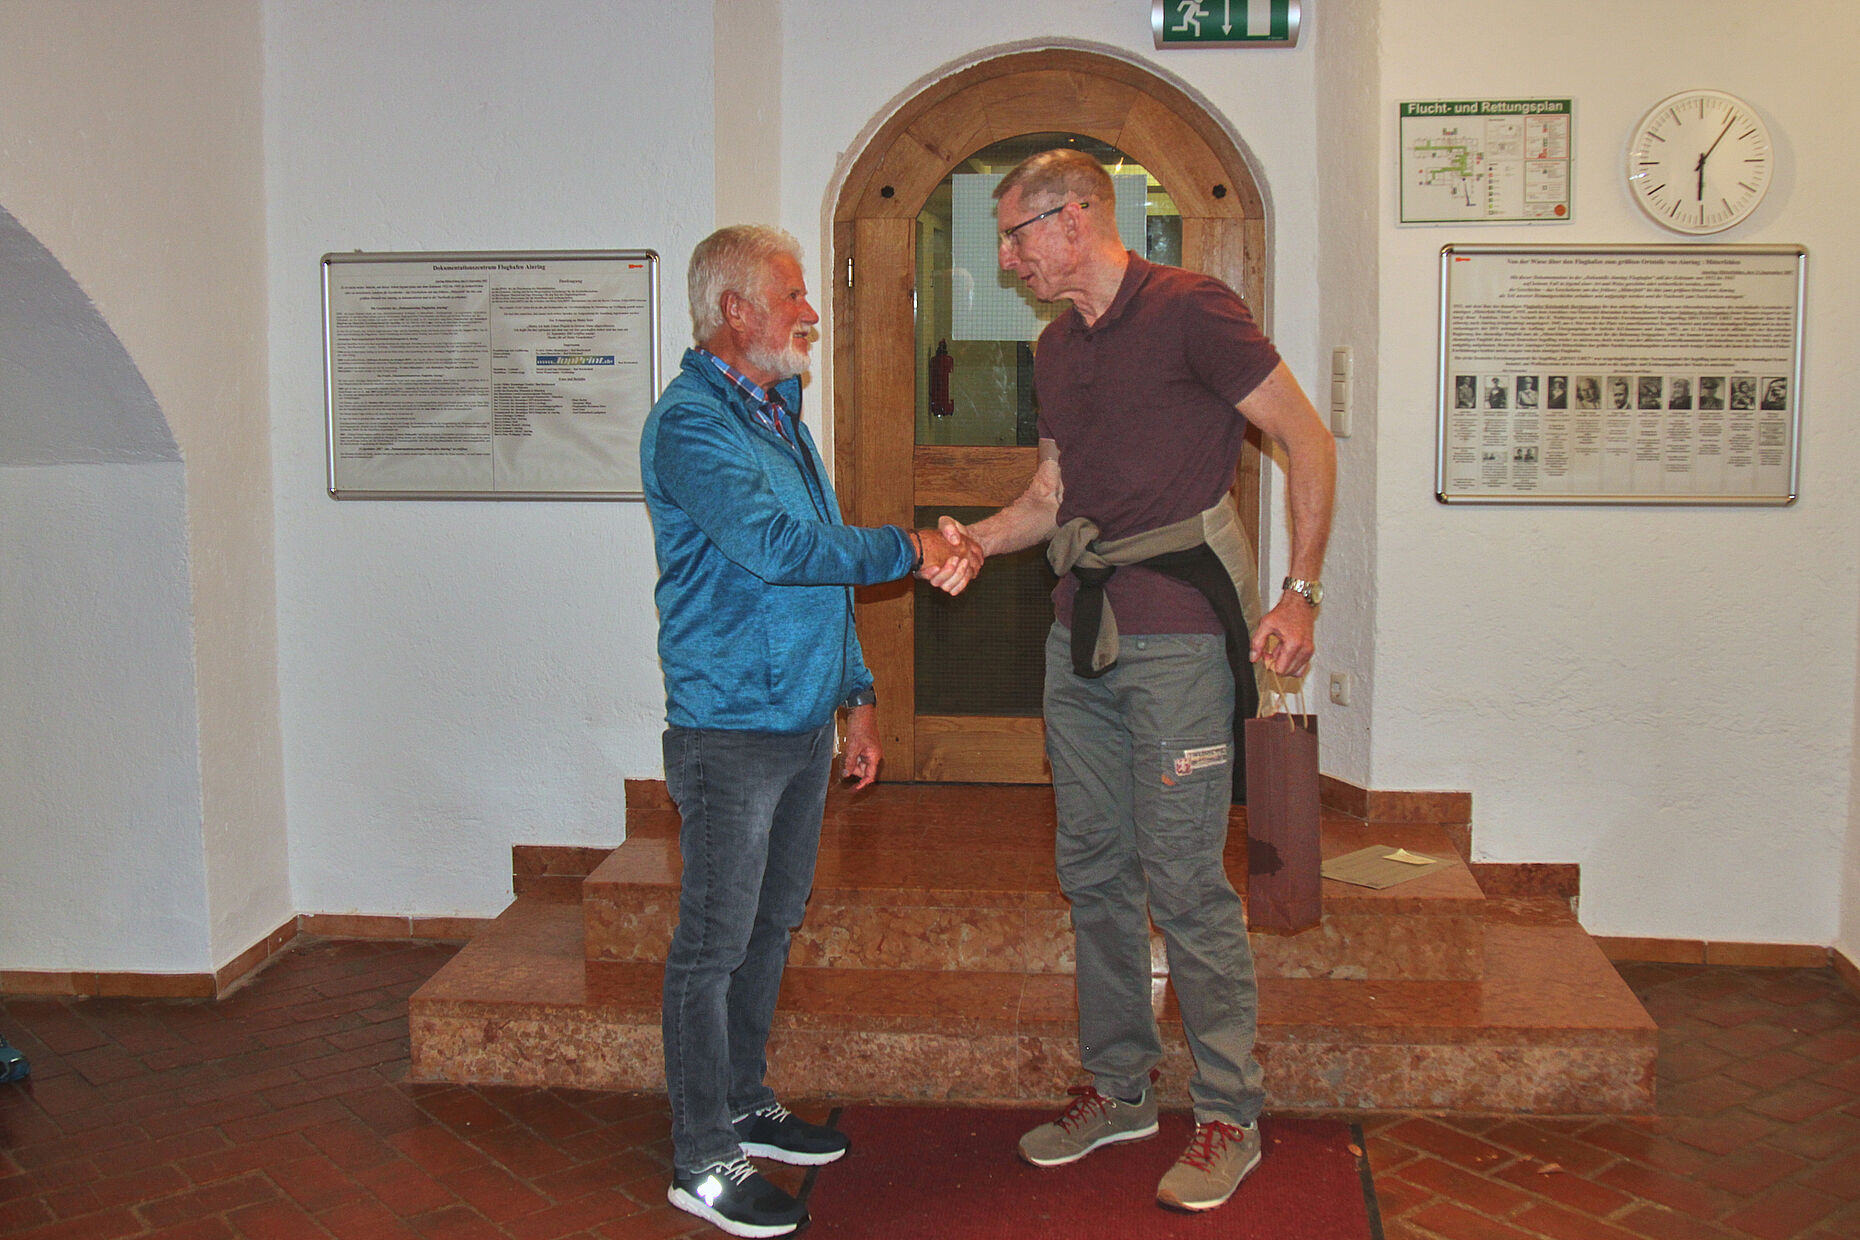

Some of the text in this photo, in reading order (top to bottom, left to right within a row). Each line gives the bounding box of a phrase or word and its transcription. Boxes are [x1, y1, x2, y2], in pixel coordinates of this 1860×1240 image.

[1408, 100, 1564, 115] Flucht- und Rettungsplan
